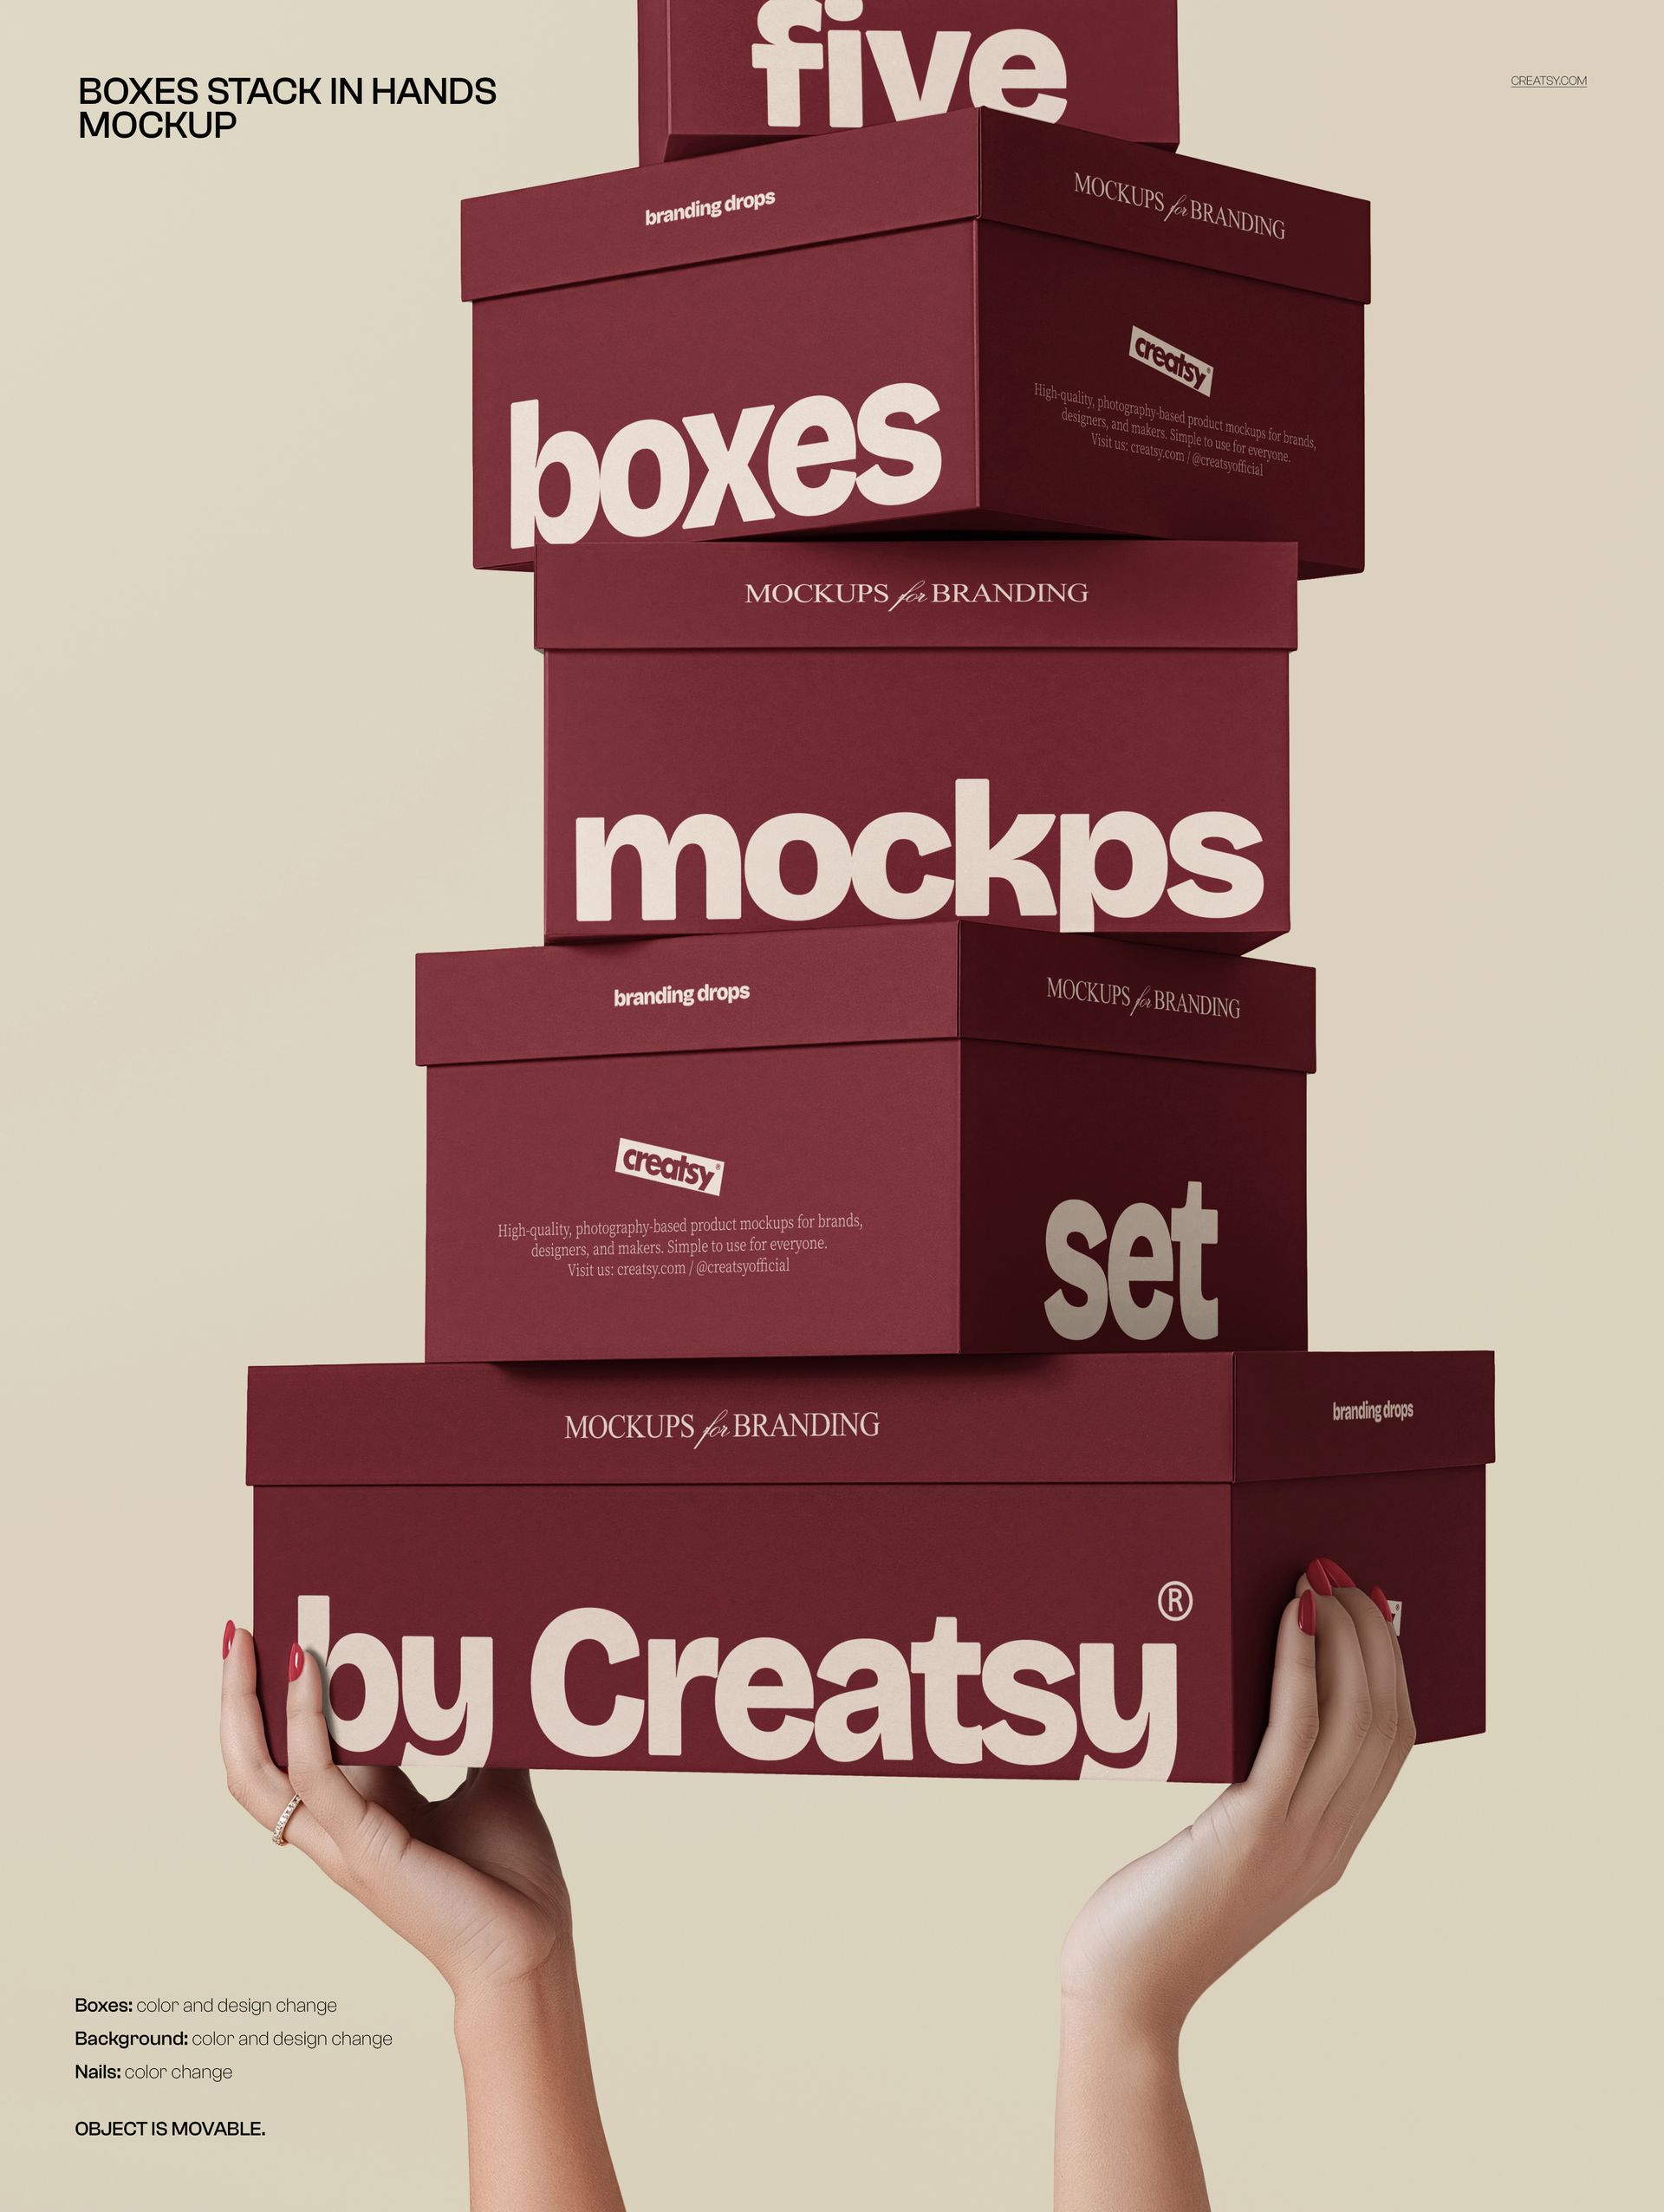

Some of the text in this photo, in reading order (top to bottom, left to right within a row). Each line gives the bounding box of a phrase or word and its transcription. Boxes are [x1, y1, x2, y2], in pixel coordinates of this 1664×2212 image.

[751, 0, 1069, 128] five
[645, 190, 776, 226] branding drops
[1074, 172, 1286, 240] MOCKUPS for BRANDING
[1034, 382, 1317, 452] High-quality, photography-based product mockups for brands,
[1061, 407, 1291, 463] designers, and makers. Simple to use for everyone.
[510, 382, 943, 550] boxes
[1090, 432, 1113, 449] Visit
[1115, 440, 1128, 452] us:
[1130, 442, 1186, 462] creatsy.com
[1192, 452, 1264, 477] @creatsyofficial
[744, 580, 1089, 612] MOCKUPS for BRANDING
[575, 777, 1265, 934] mockps
[614, 983, 751, 1007] branding drops
[1046, 976, 1241, 1019] MOCKUPS for BRANDING
[497, 1212, 863, 1241] High-quality, photography-based product mockups for brands,
[530, 1236, 828, 1260] designers, and makers. Simple to use for everyone.
[568, 1257, 790, 1279] Visit us: creatsy.com / @creatsyofficial
[1043, 1181, 1219, 1341] set
[563, 1409, 881, 1450] MOCKUPS for BRANDING
[1332, 1400, 1414, 1423] branding drops
[297, 1595, 493, 1768] by
